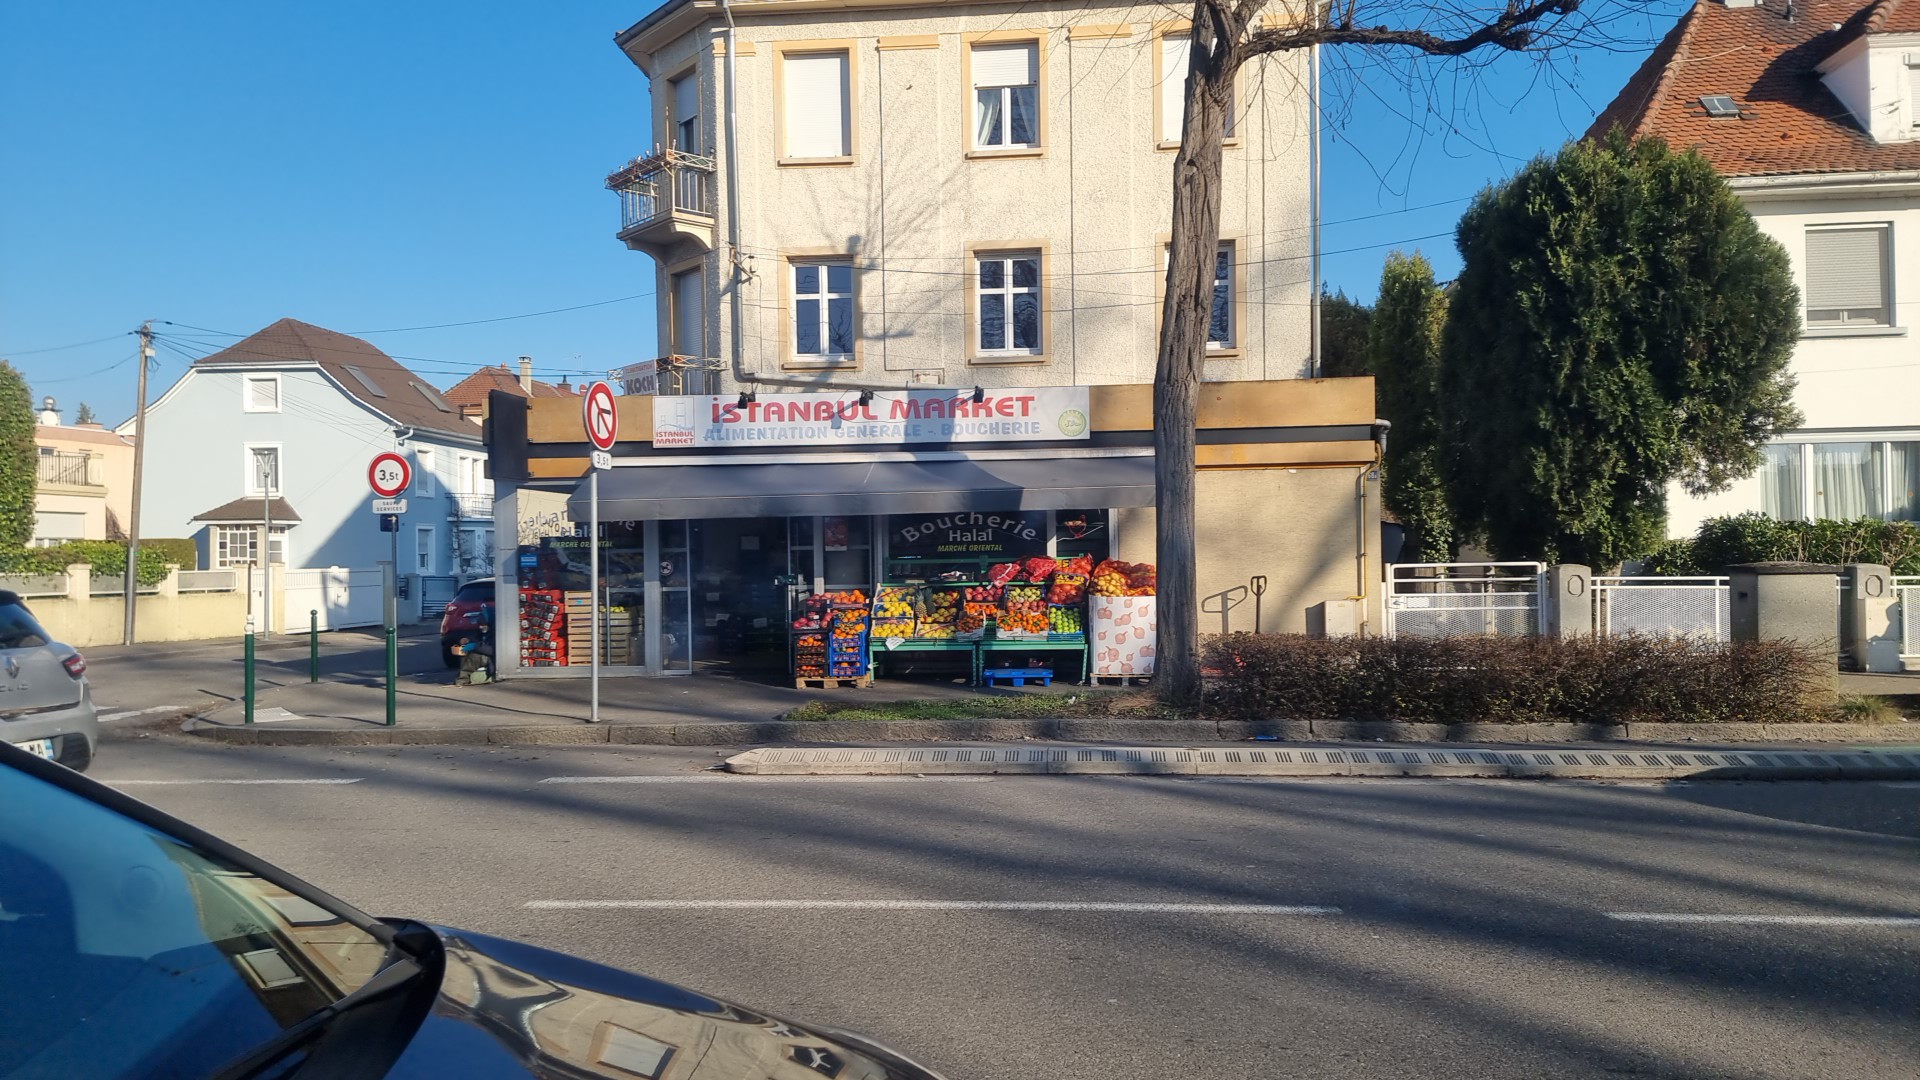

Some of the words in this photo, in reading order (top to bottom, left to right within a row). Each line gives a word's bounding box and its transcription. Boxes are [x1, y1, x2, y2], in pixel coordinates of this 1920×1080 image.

[626, 375, 655, 395] KOCH
[890, 395, 1035, 420] MARKET
[704, 425, 828, 441] ALIMENTATION
[942, 421, 1040, 437] BOUCHERIE
[379, 469, 399, 482] 3,5t
[900, 512, 1037, 542] Boucherie
[949, 529, 993, 542] Halal
[968, 544, 1003, 552] ORIENTAL
